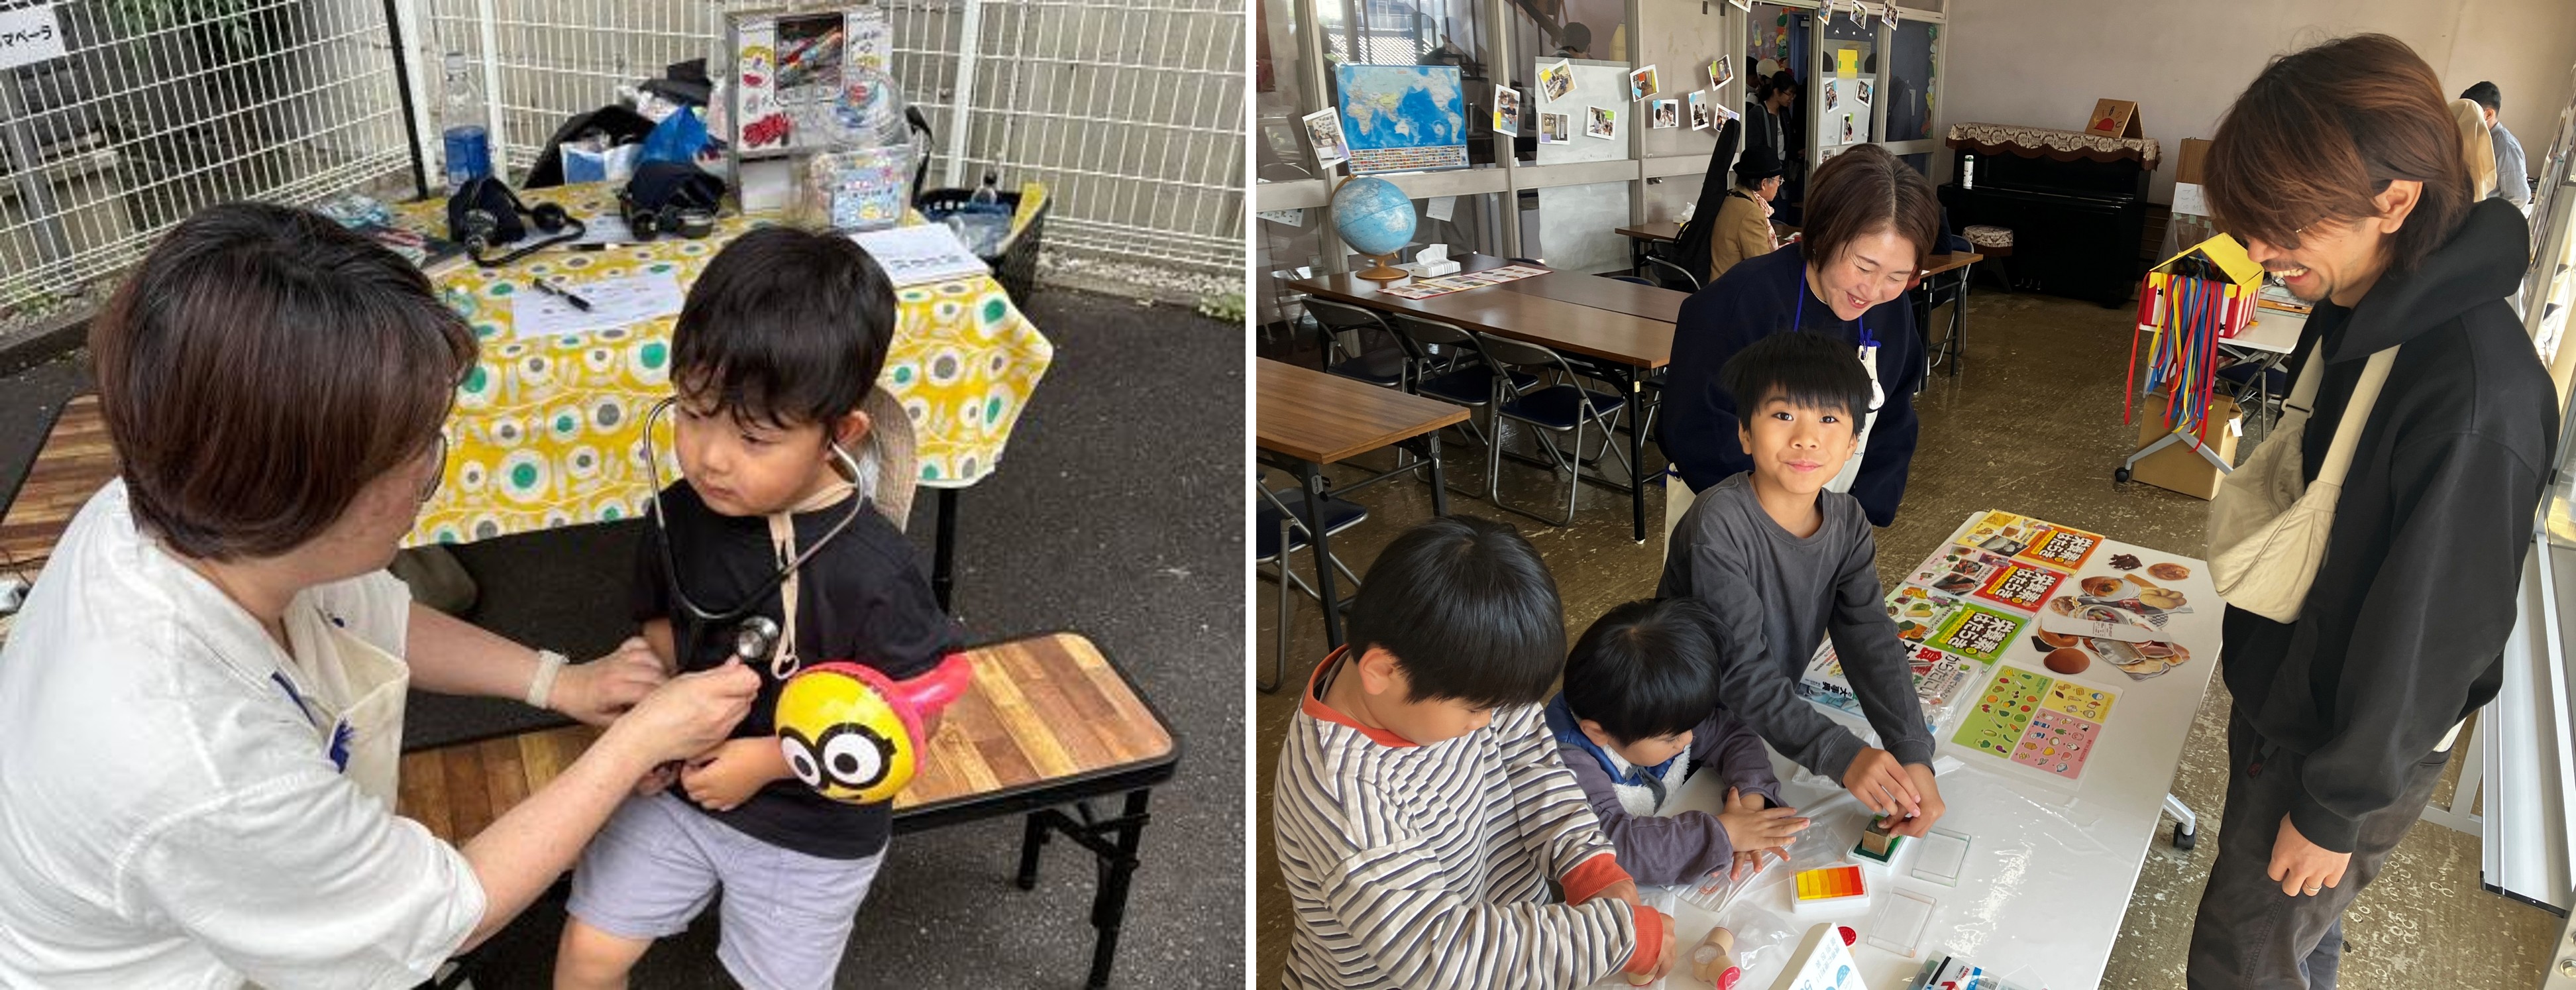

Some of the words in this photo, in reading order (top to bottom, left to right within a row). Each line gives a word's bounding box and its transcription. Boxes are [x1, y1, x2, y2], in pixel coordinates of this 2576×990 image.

[2039, 532, 2074, 558] はたらき
[1996, 569, 2033, 598] はたらき
[1948, 612, 1992, 648] はたらき
[1917, 653, 1961, 700] からだにい
